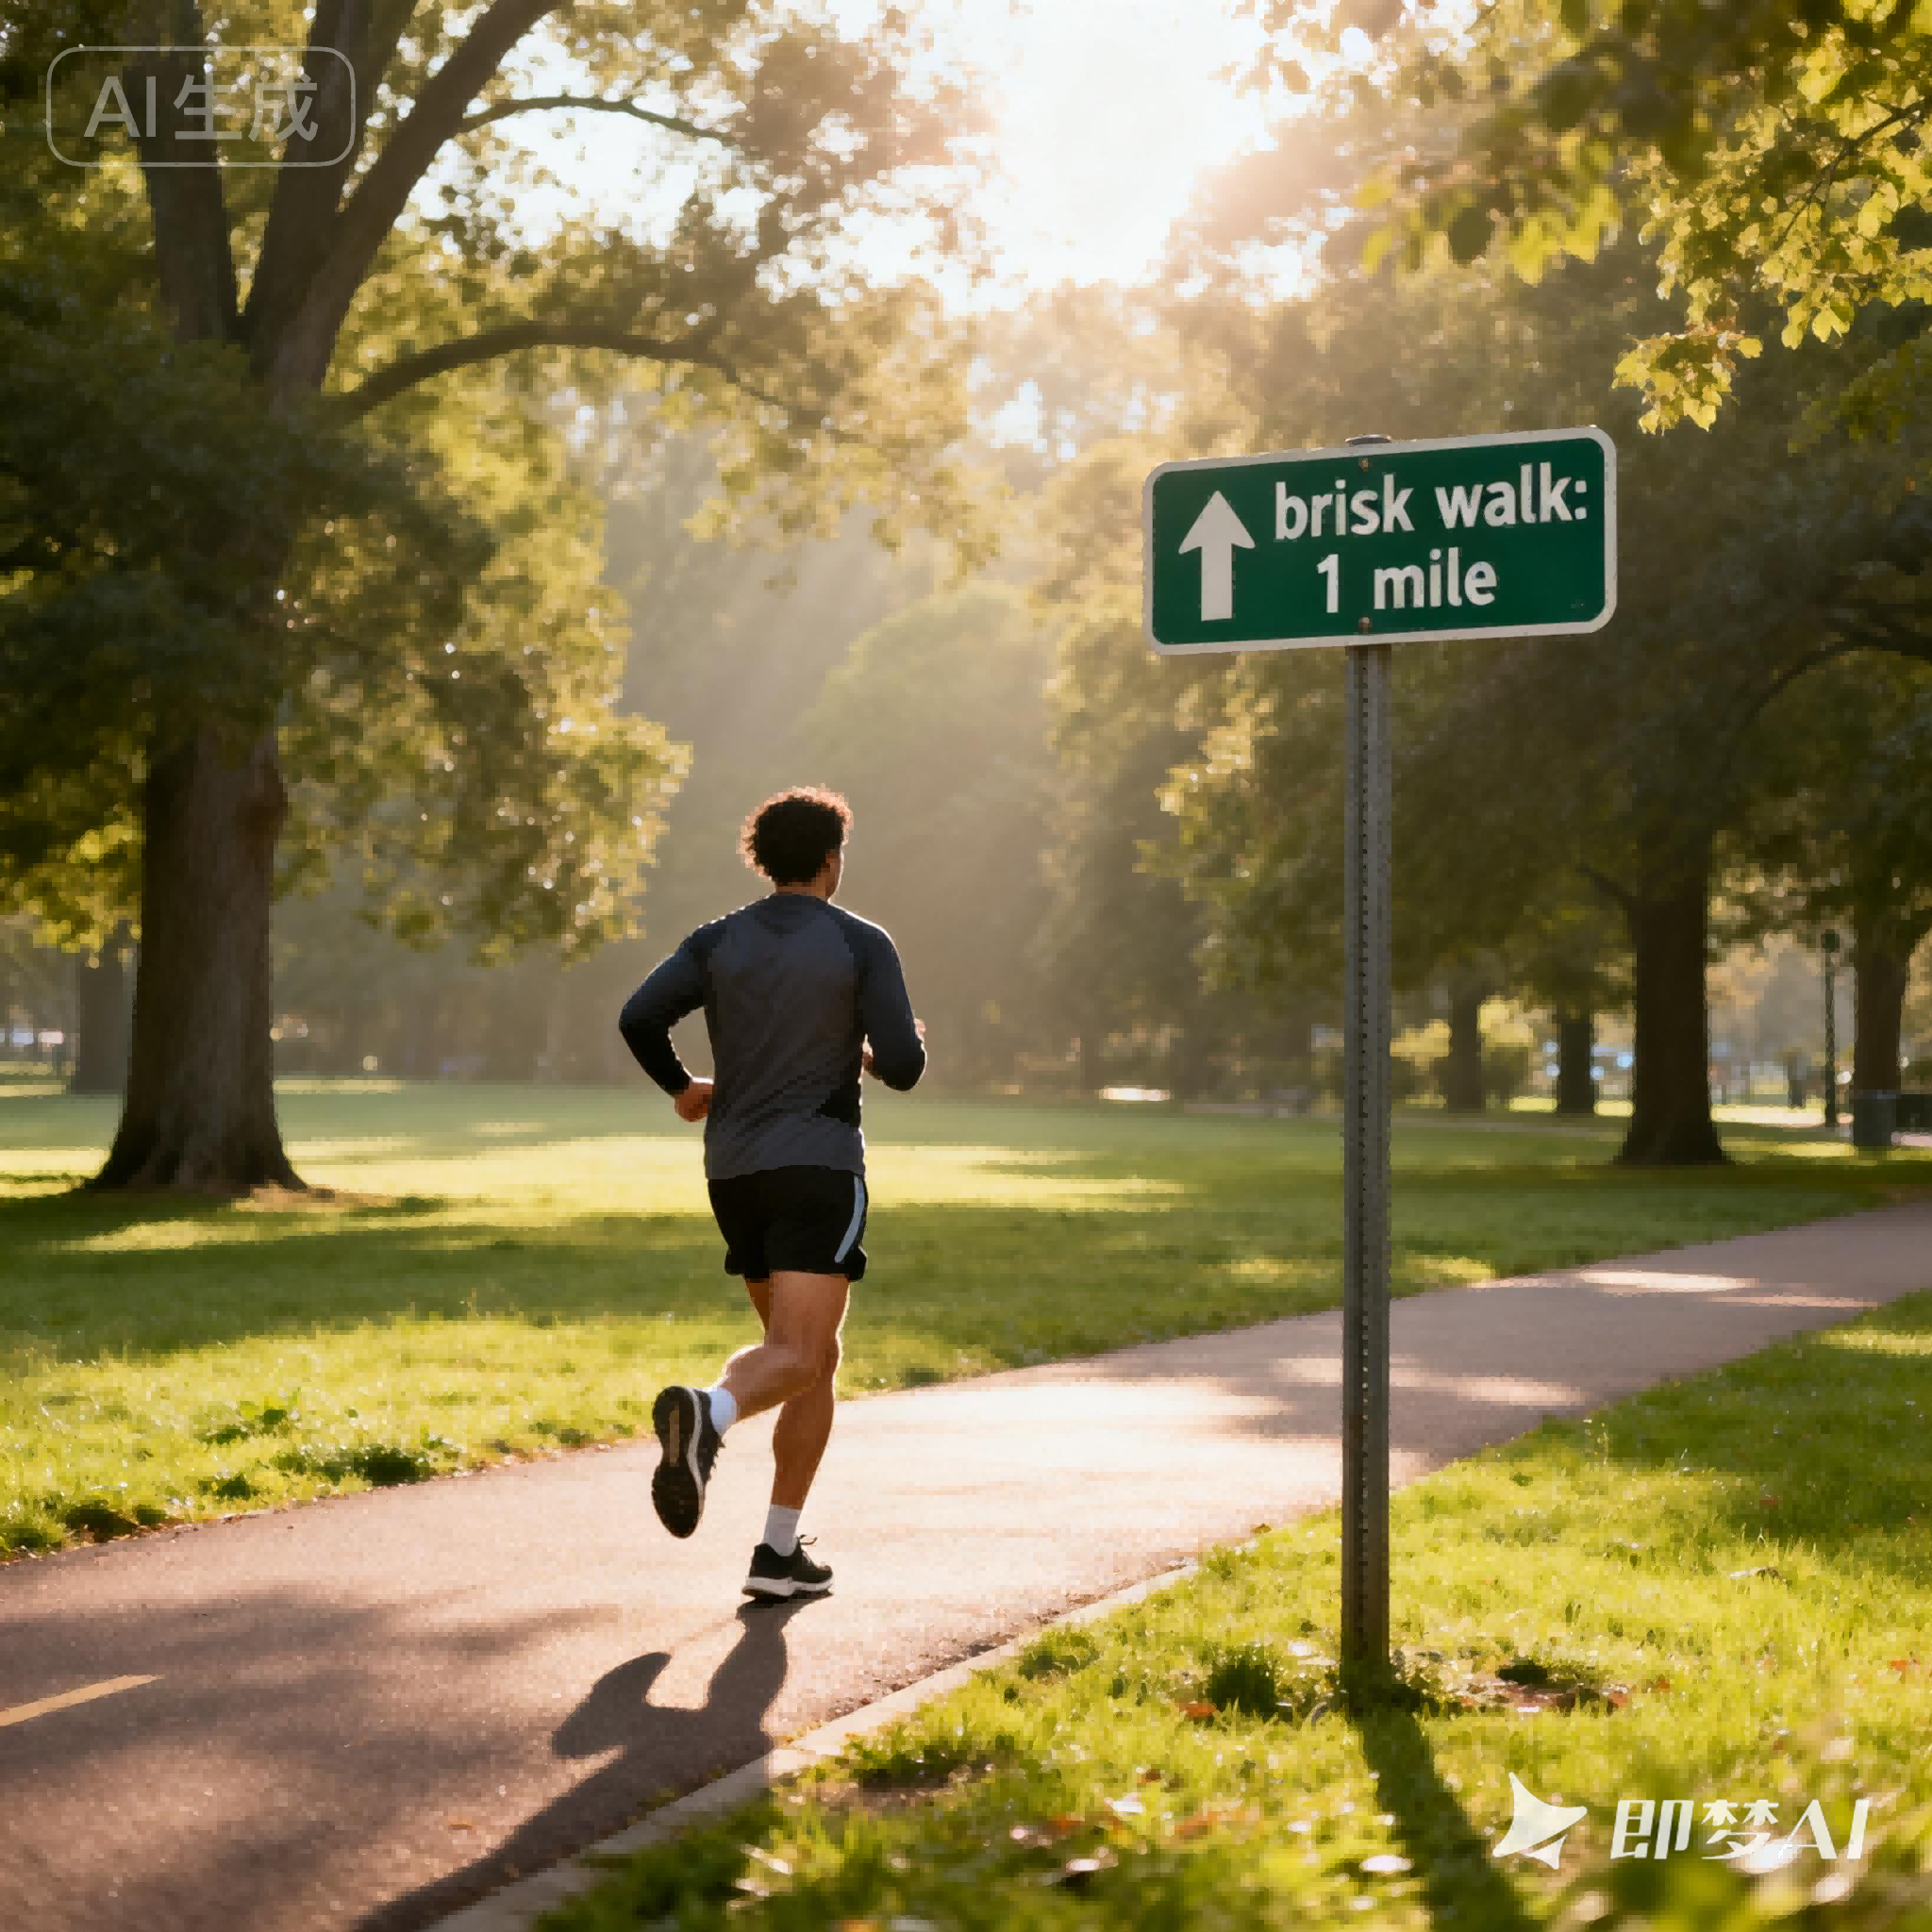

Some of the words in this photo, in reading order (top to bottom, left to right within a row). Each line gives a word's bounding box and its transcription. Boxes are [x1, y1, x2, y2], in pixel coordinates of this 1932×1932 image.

[1274, 474, 1415, 540] brisk
[1434, 462, 1588, 529] walk:
[1316, 554, 1340, 613] 1
[1373, 547, 1498, 610] mile
